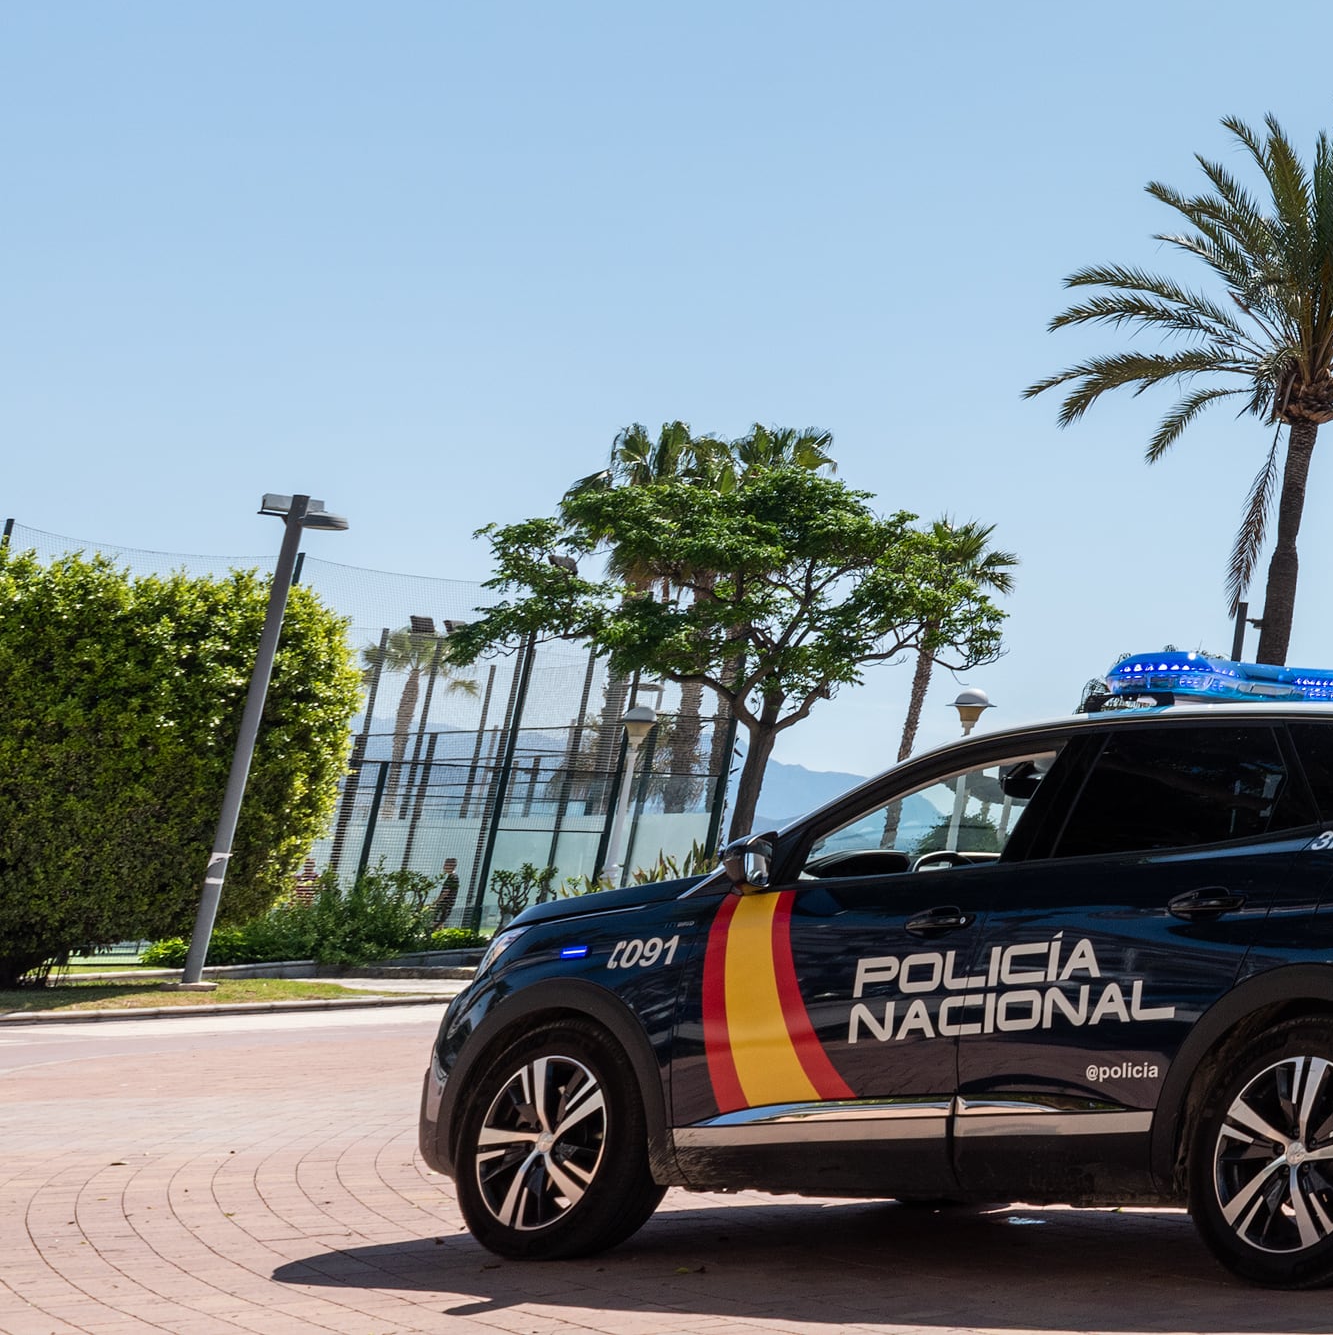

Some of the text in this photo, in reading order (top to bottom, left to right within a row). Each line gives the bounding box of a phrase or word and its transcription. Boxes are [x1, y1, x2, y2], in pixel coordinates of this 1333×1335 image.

[853, 931, 1100, 998] POLICÍA
[848, 980, 1176, 1044] NACIONAL
[1085, 1062, 1159, 1082] @policia
